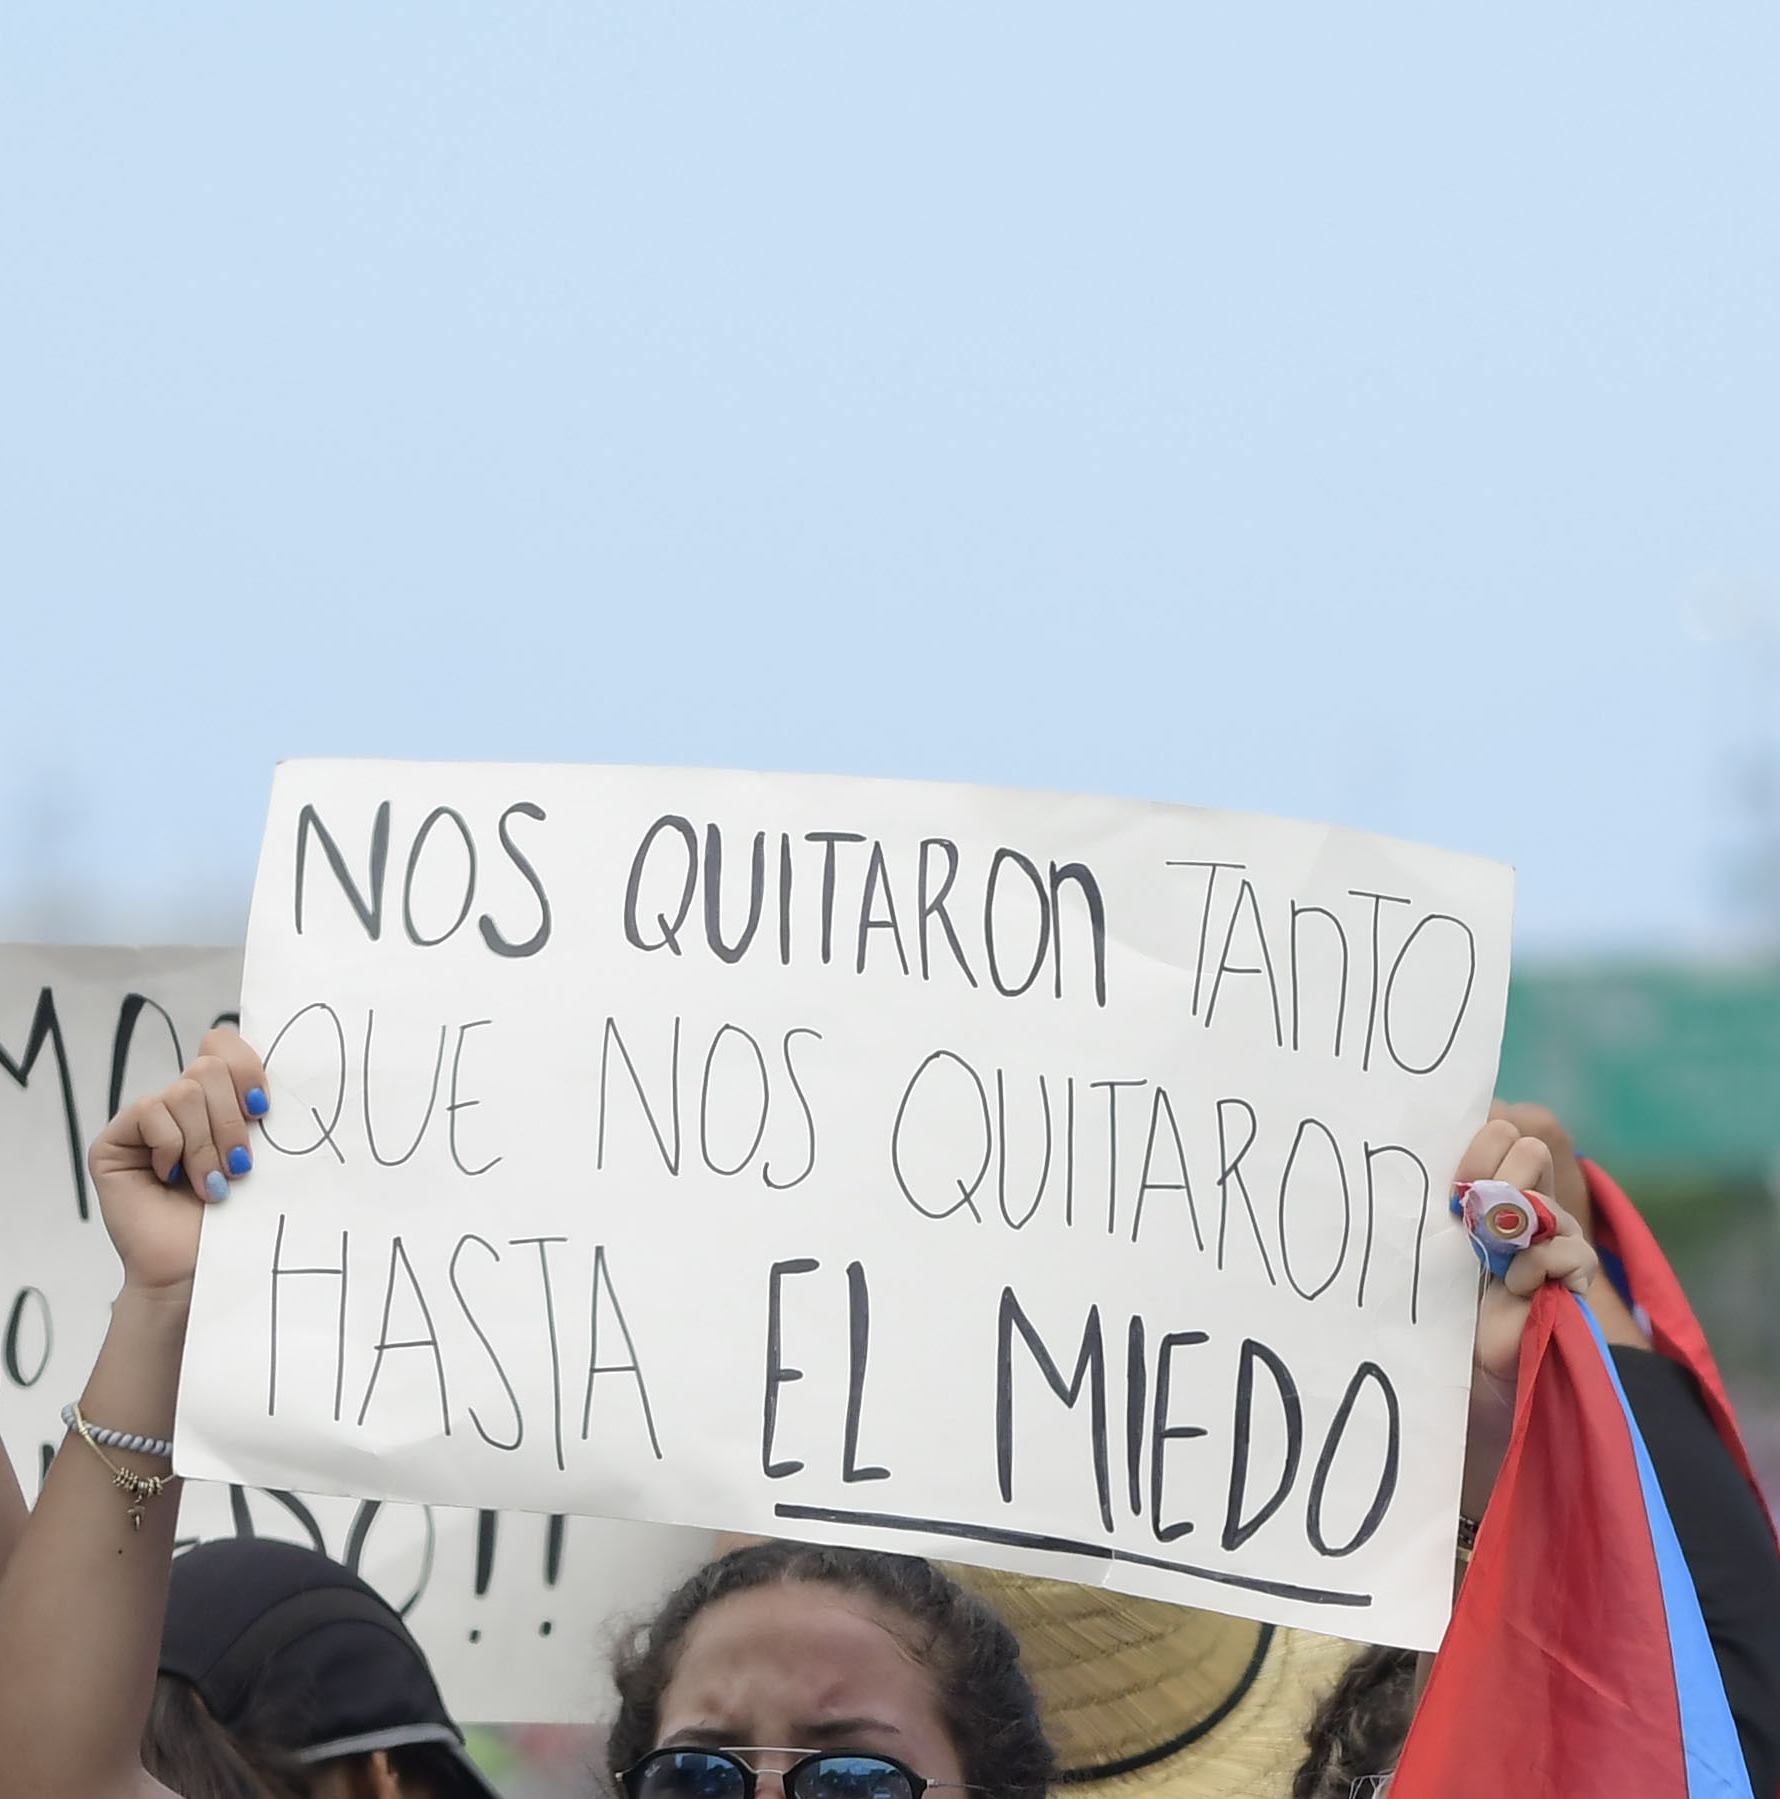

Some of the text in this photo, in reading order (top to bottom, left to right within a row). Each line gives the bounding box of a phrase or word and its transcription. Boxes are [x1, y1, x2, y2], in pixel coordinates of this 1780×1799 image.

[295, 801, 552, 958] NOS
[256, 1003, 503, 1177] QUE
[597, 1016, 823, 1190] NOS
[268, 1214, 1401, 1559] HASTA EL MIEDO
